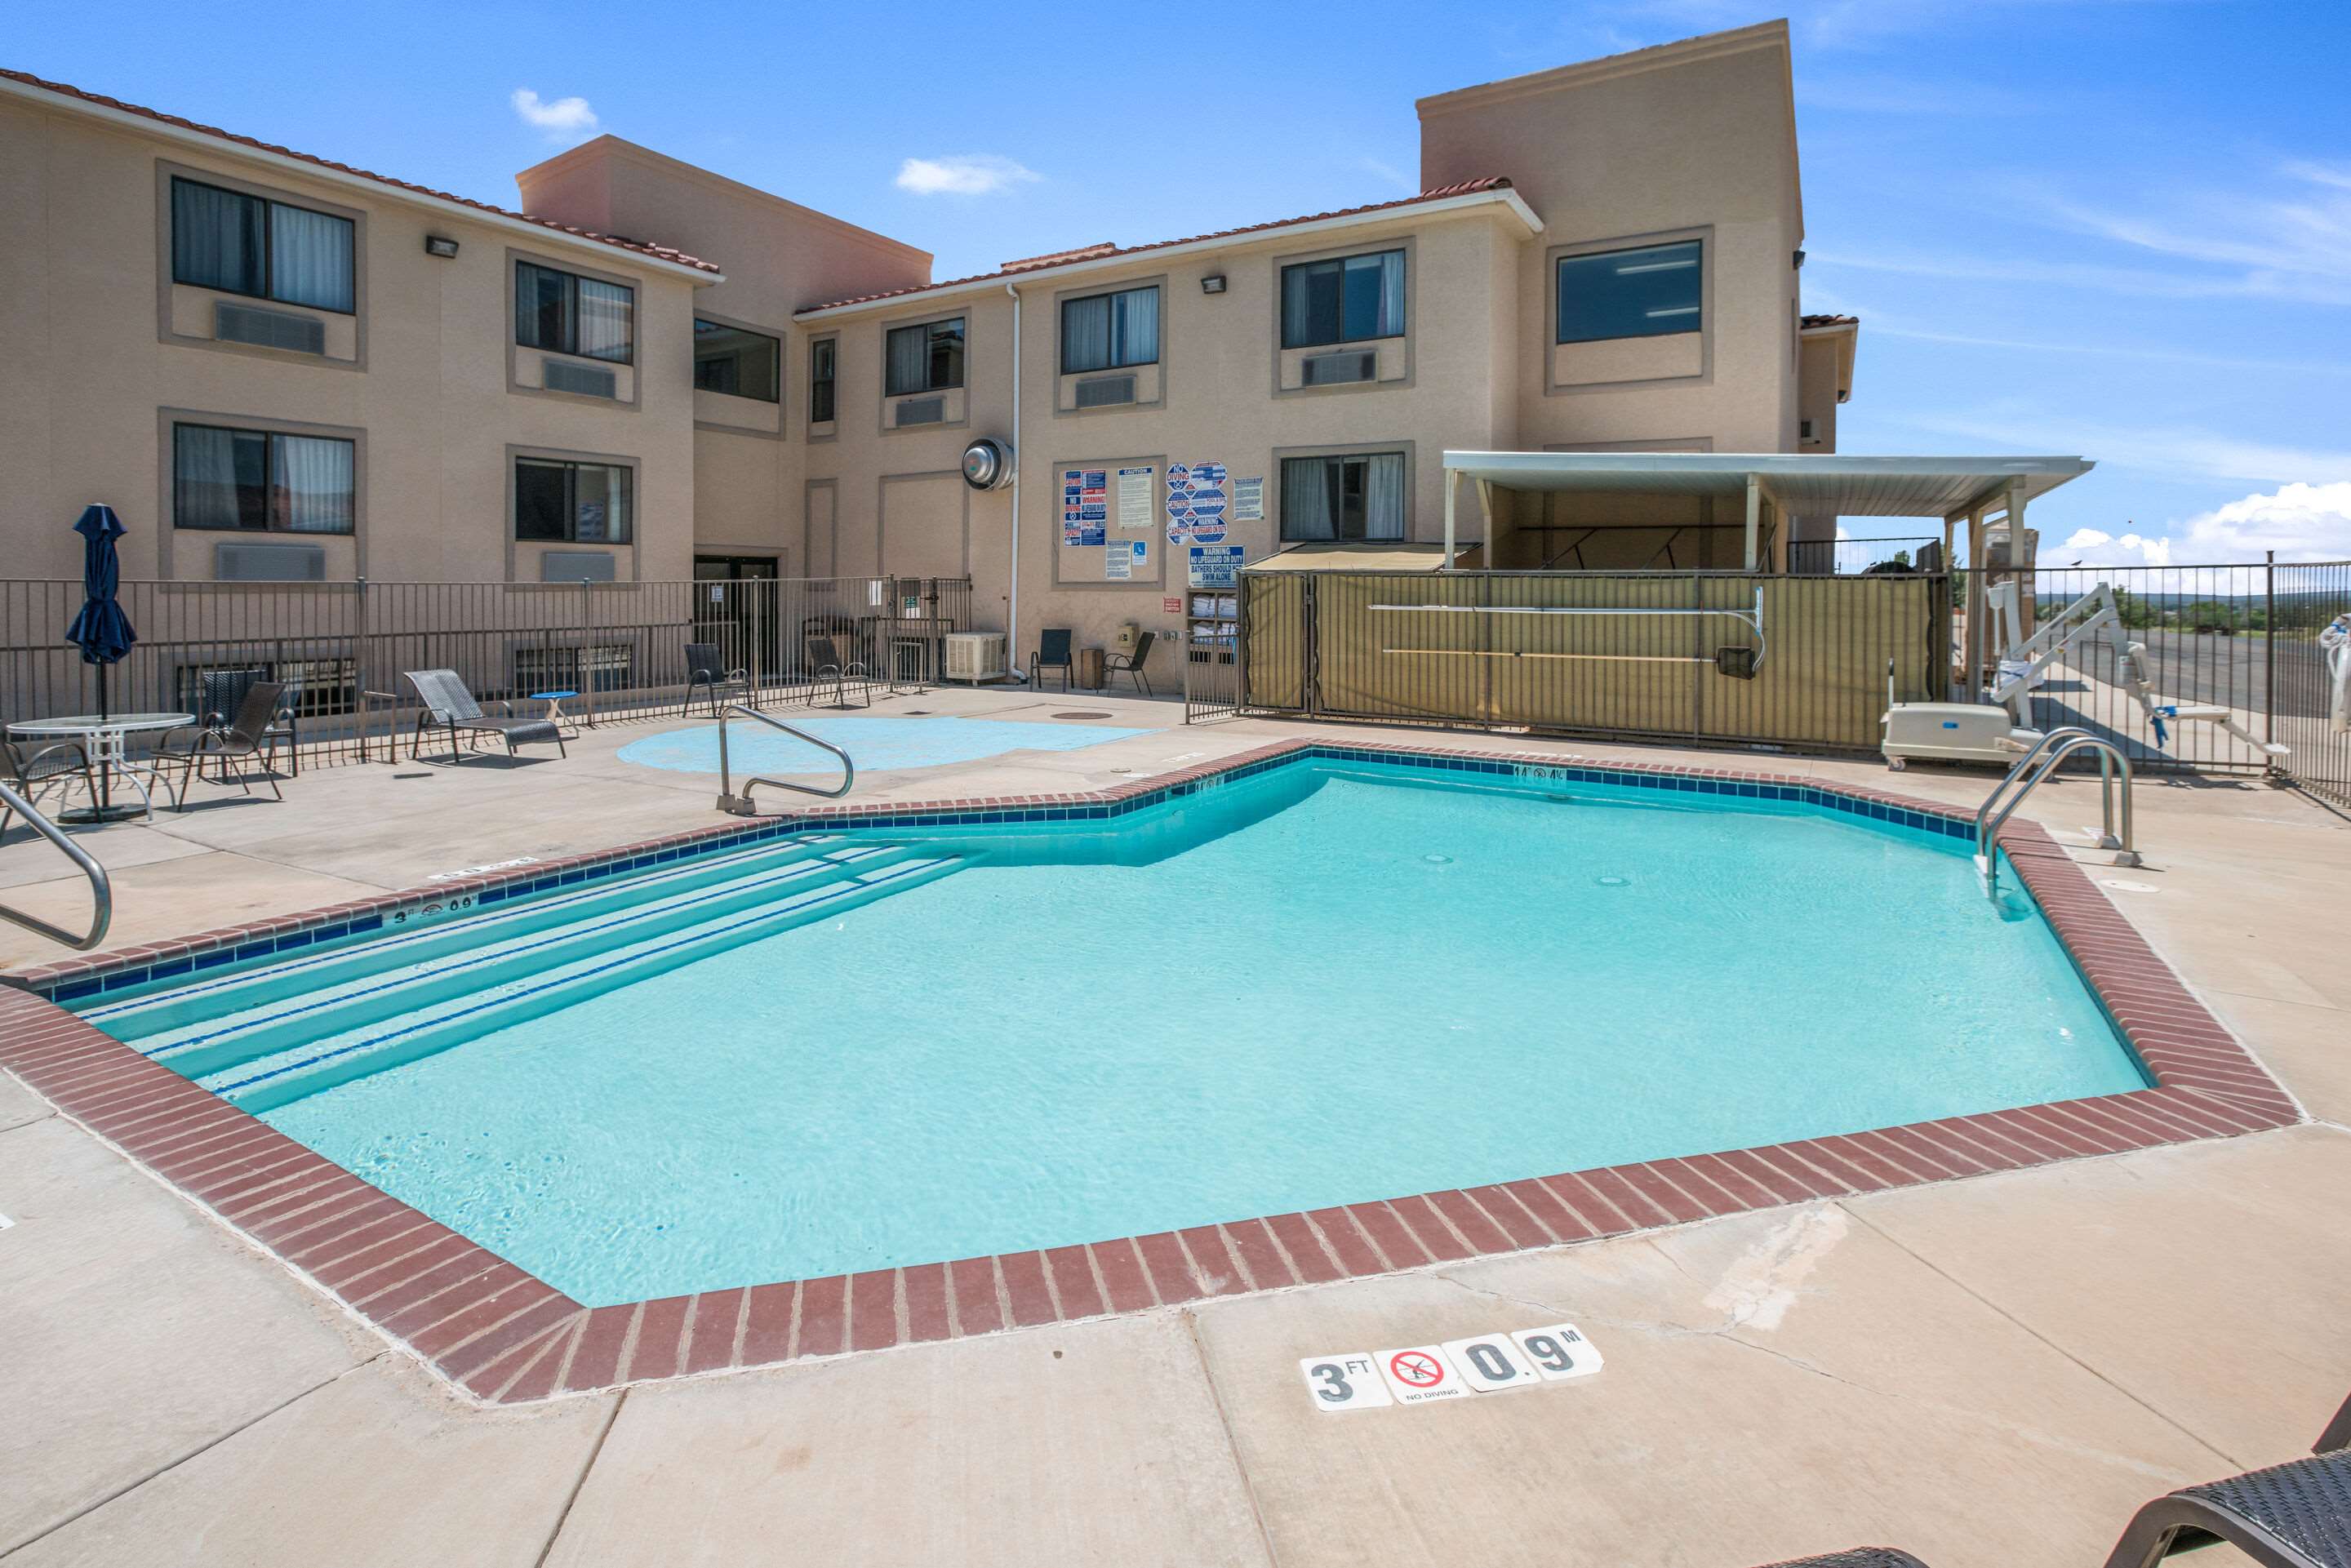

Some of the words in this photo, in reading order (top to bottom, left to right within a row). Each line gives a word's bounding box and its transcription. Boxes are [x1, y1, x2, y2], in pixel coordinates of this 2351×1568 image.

[1198, 517, 1219, 525] WARNING
[1168, 527, 1190, 535] CAPACITY
[1202, 547, 1231, 555] WARNING
[1191, 565, 1212, 573] BATHERS
[1213, 565, 1231, 573] SHOULD
[450, 897, 471, 912] 0.9
[394, 911, 407, 924] 3
[1464, 1335, 1575, 1382] 0.9
[1562, 1329, 1582, 1344] M
[1310, 1363, 1354, 1403] 3
[1345, 1359, 1369, 1375] FT
[1405, 1393, 1422, 1402] NO
[1424, 1388, 1460, 1400] DIVING
